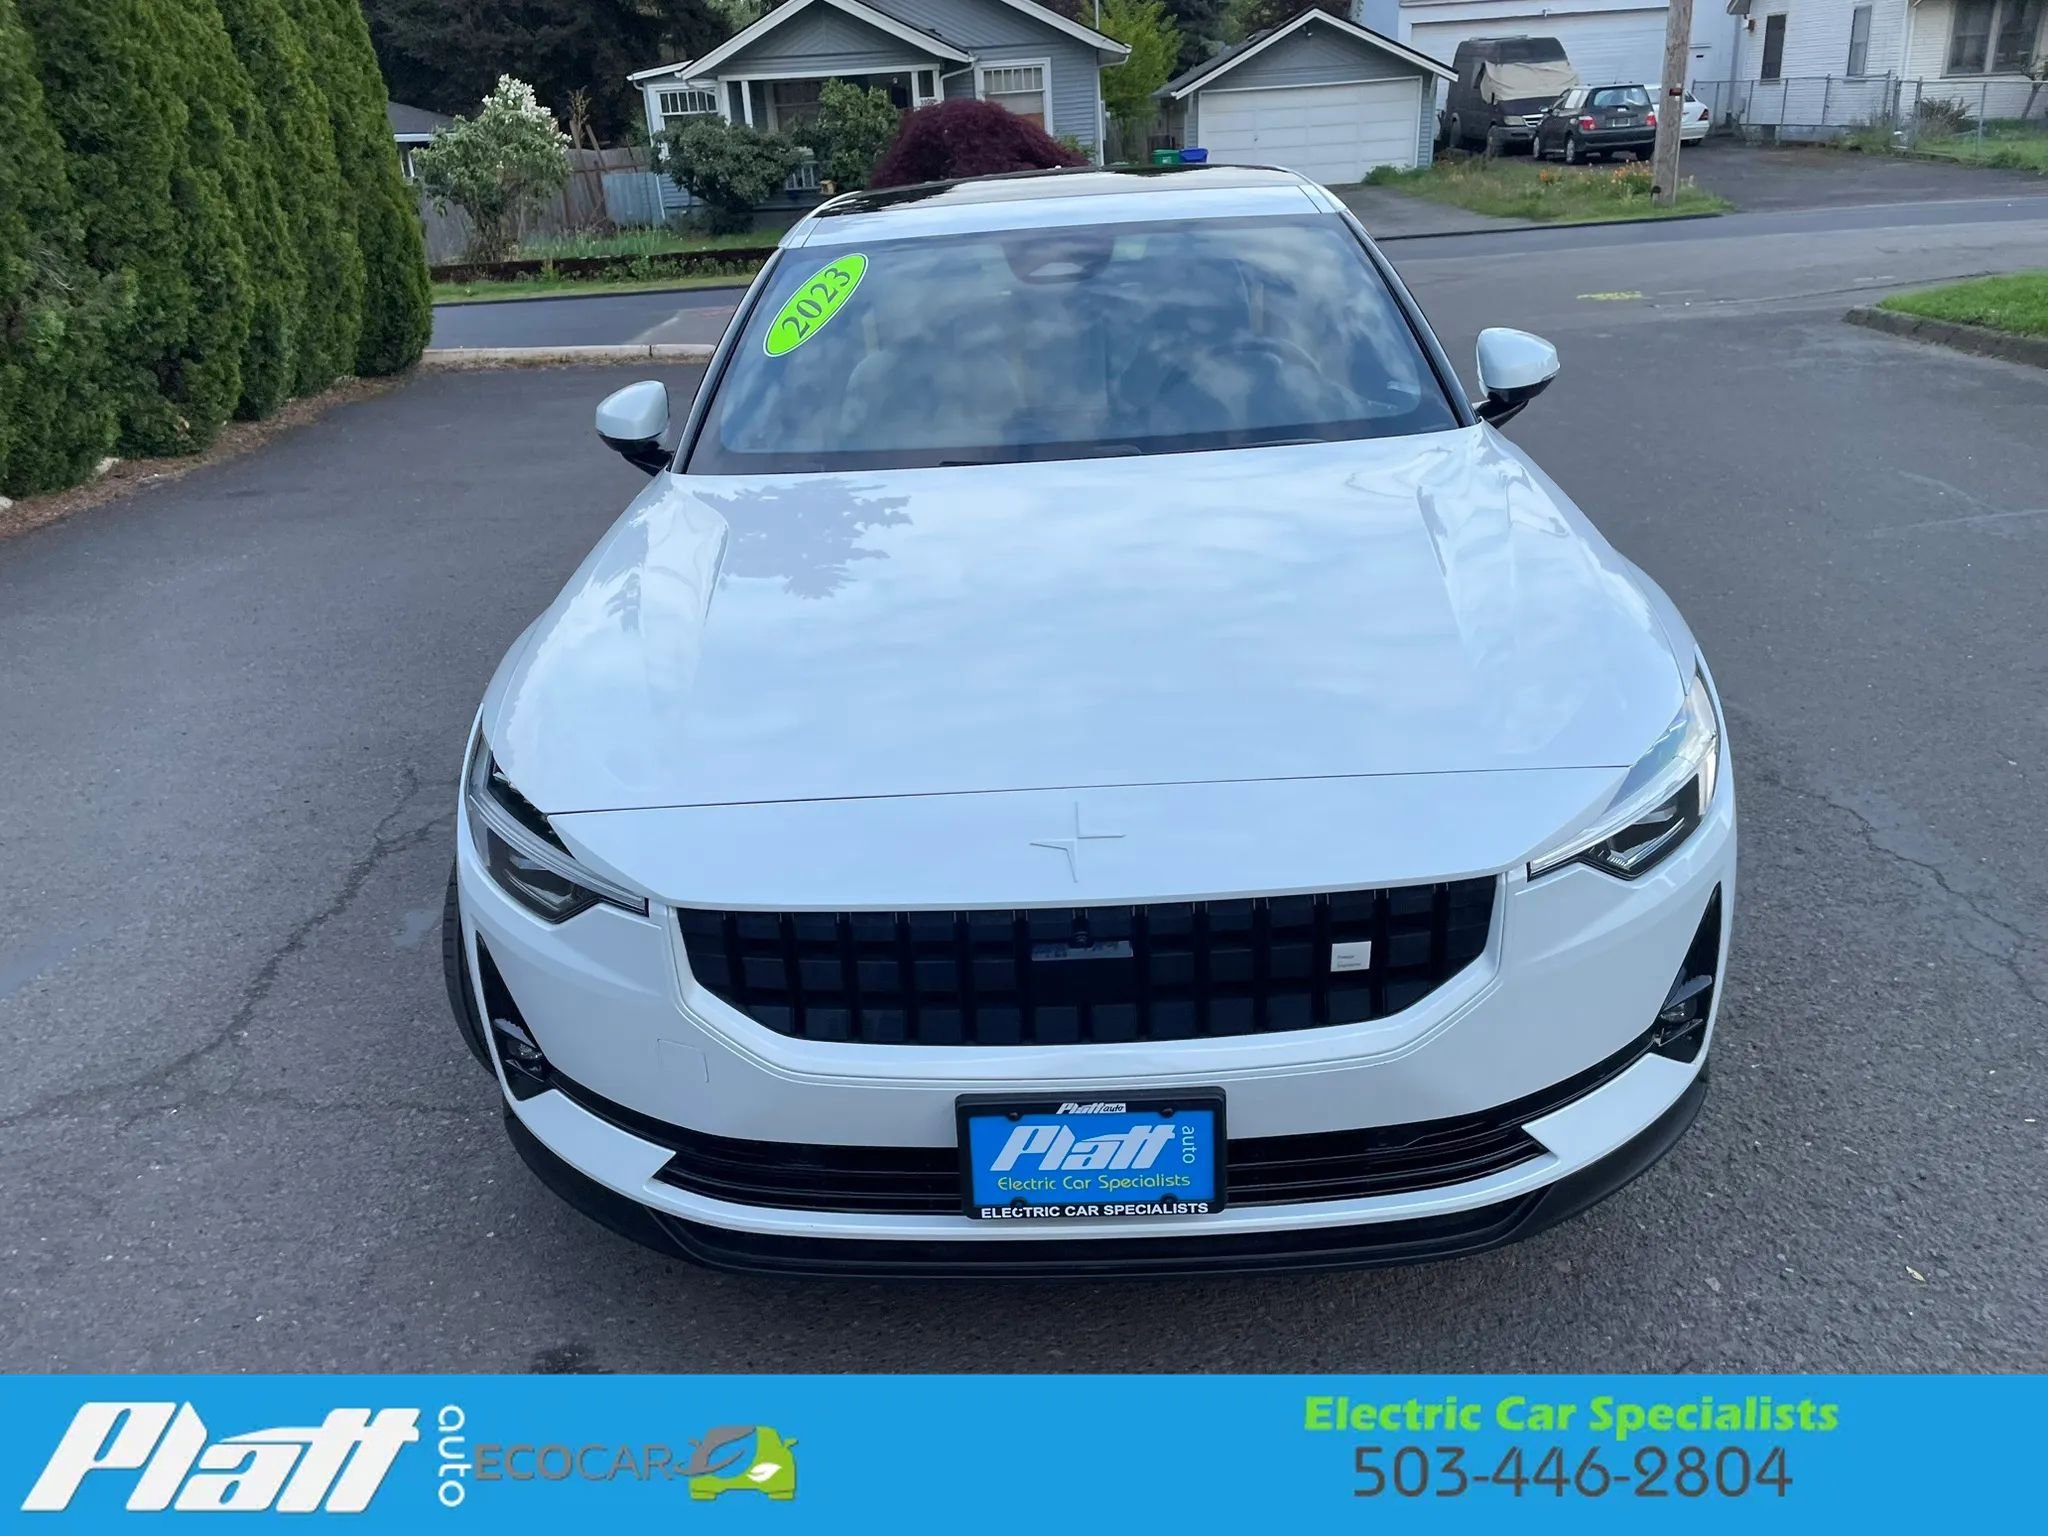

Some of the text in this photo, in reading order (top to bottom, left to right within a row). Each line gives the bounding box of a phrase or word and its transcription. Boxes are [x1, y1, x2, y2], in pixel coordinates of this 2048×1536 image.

[782, 268, 850, 338] 2023
[990, 1124, 1176, 1171] Platt
[1181, 1125, 1197, 1164] auto
[997, 1173, 1191, 1193] Electric Car Specialists
[981, 1202, 1209, 1218] ELECTRIC CAR SPECIALISTS
